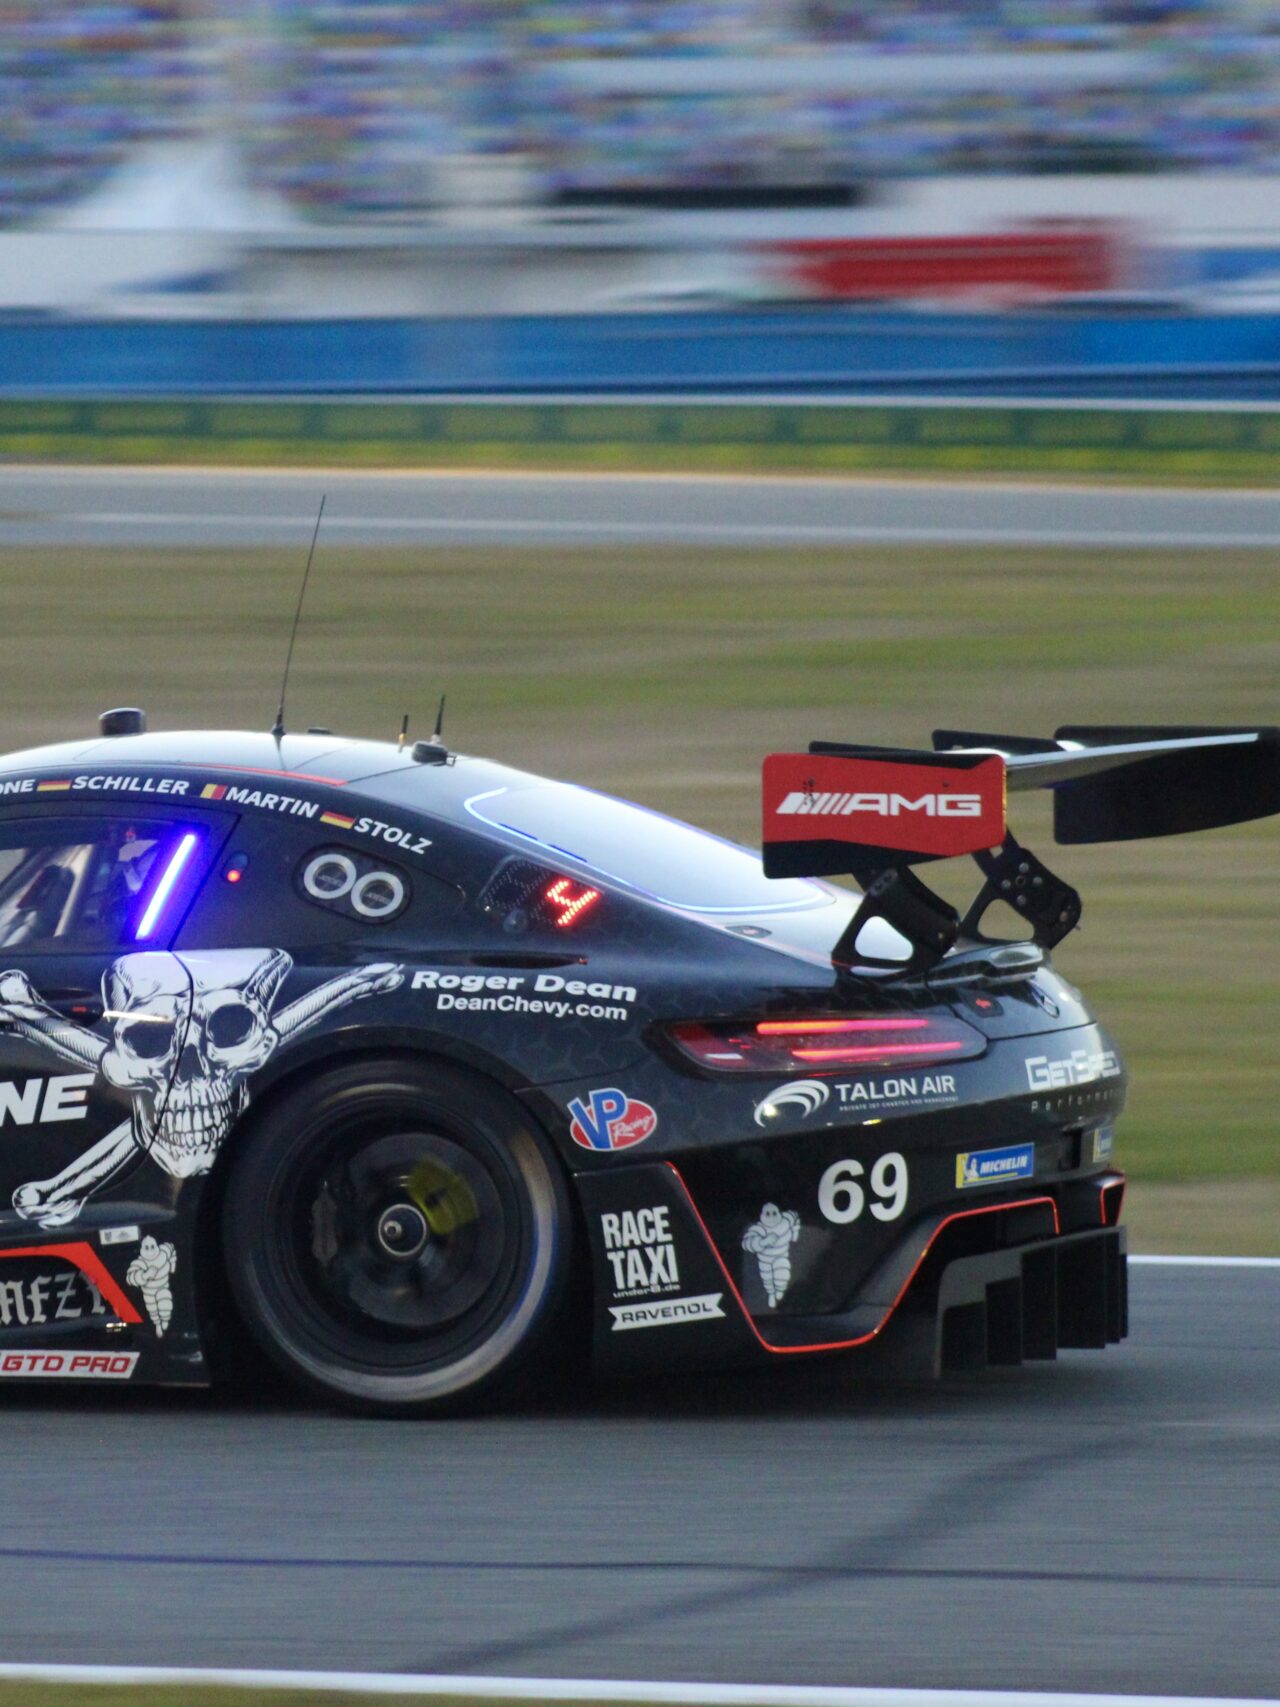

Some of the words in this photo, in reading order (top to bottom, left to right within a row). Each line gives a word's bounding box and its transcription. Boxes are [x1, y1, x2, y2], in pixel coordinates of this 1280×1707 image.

[72, 775, 190, 796] SCHILLER
[226, 786, 320, 818] MARTIN
[840, 793, 981, 816] AMG
[354, 817, 432, 854] STOLZ
[412, 970, 524, 994] Roger
[534, 974, 637, 1001] Dean
[437, 994, 628, 1021] DeanChevy.com
[835, 1078, 917, 1102] TALON
[922, 1075, 956, 1095] AIR
[566, 1087, 629, 1151] VP
[979, 1154, 1028, 1174] MICHELIN
[818, 1152, 909, 1224] 69
[601, 1205, 673, 1249] RACE
[607, 1244, 679, 1290] TAXI
[621, 1303, 713, 1323] RAVENOL
[1, 1355, 65, 1372] GTD
[70, 1356, 132, 1373] PRO
